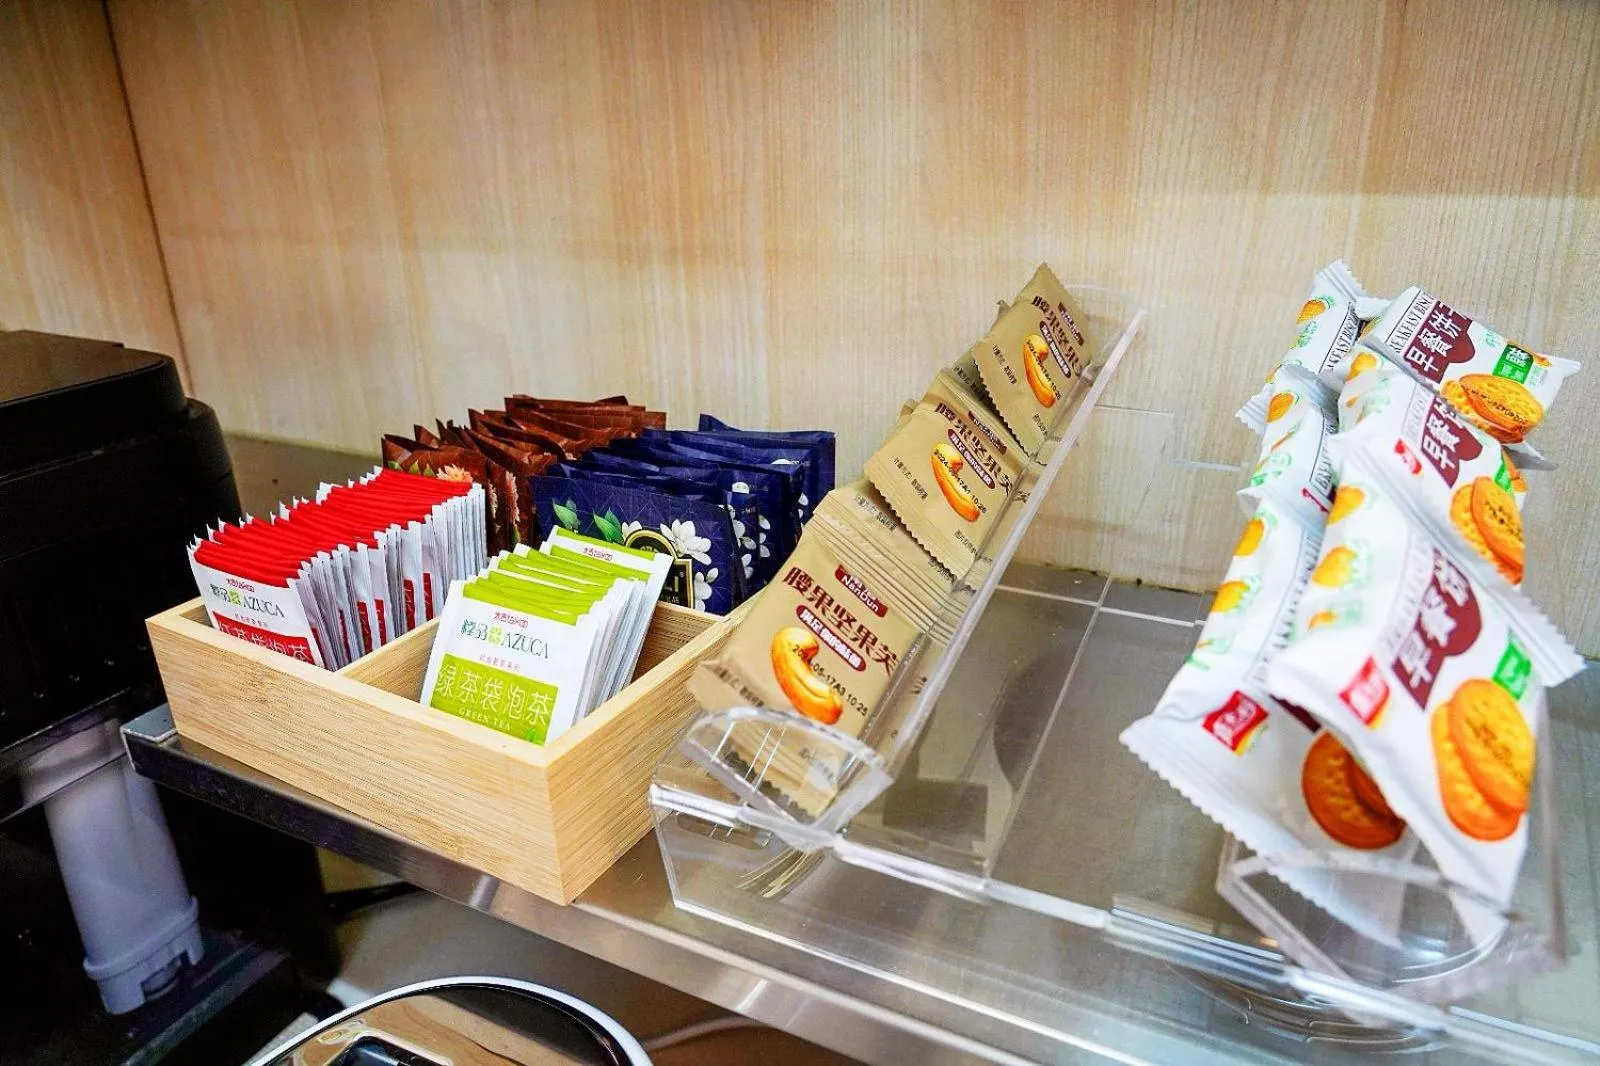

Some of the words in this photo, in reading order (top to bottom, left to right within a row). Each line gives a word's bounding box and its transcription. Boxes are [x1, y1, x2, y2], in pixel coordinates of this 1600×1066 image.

[1032, 295, 1083, 377] 腰果坚果
[243, 595, 285, 618] AZUCA
[839, 574, 882, 612] NanDun
[500, 632, 549, 660] AZUCA
[436, 663, 552, 726] 绿茶袋泡茶
